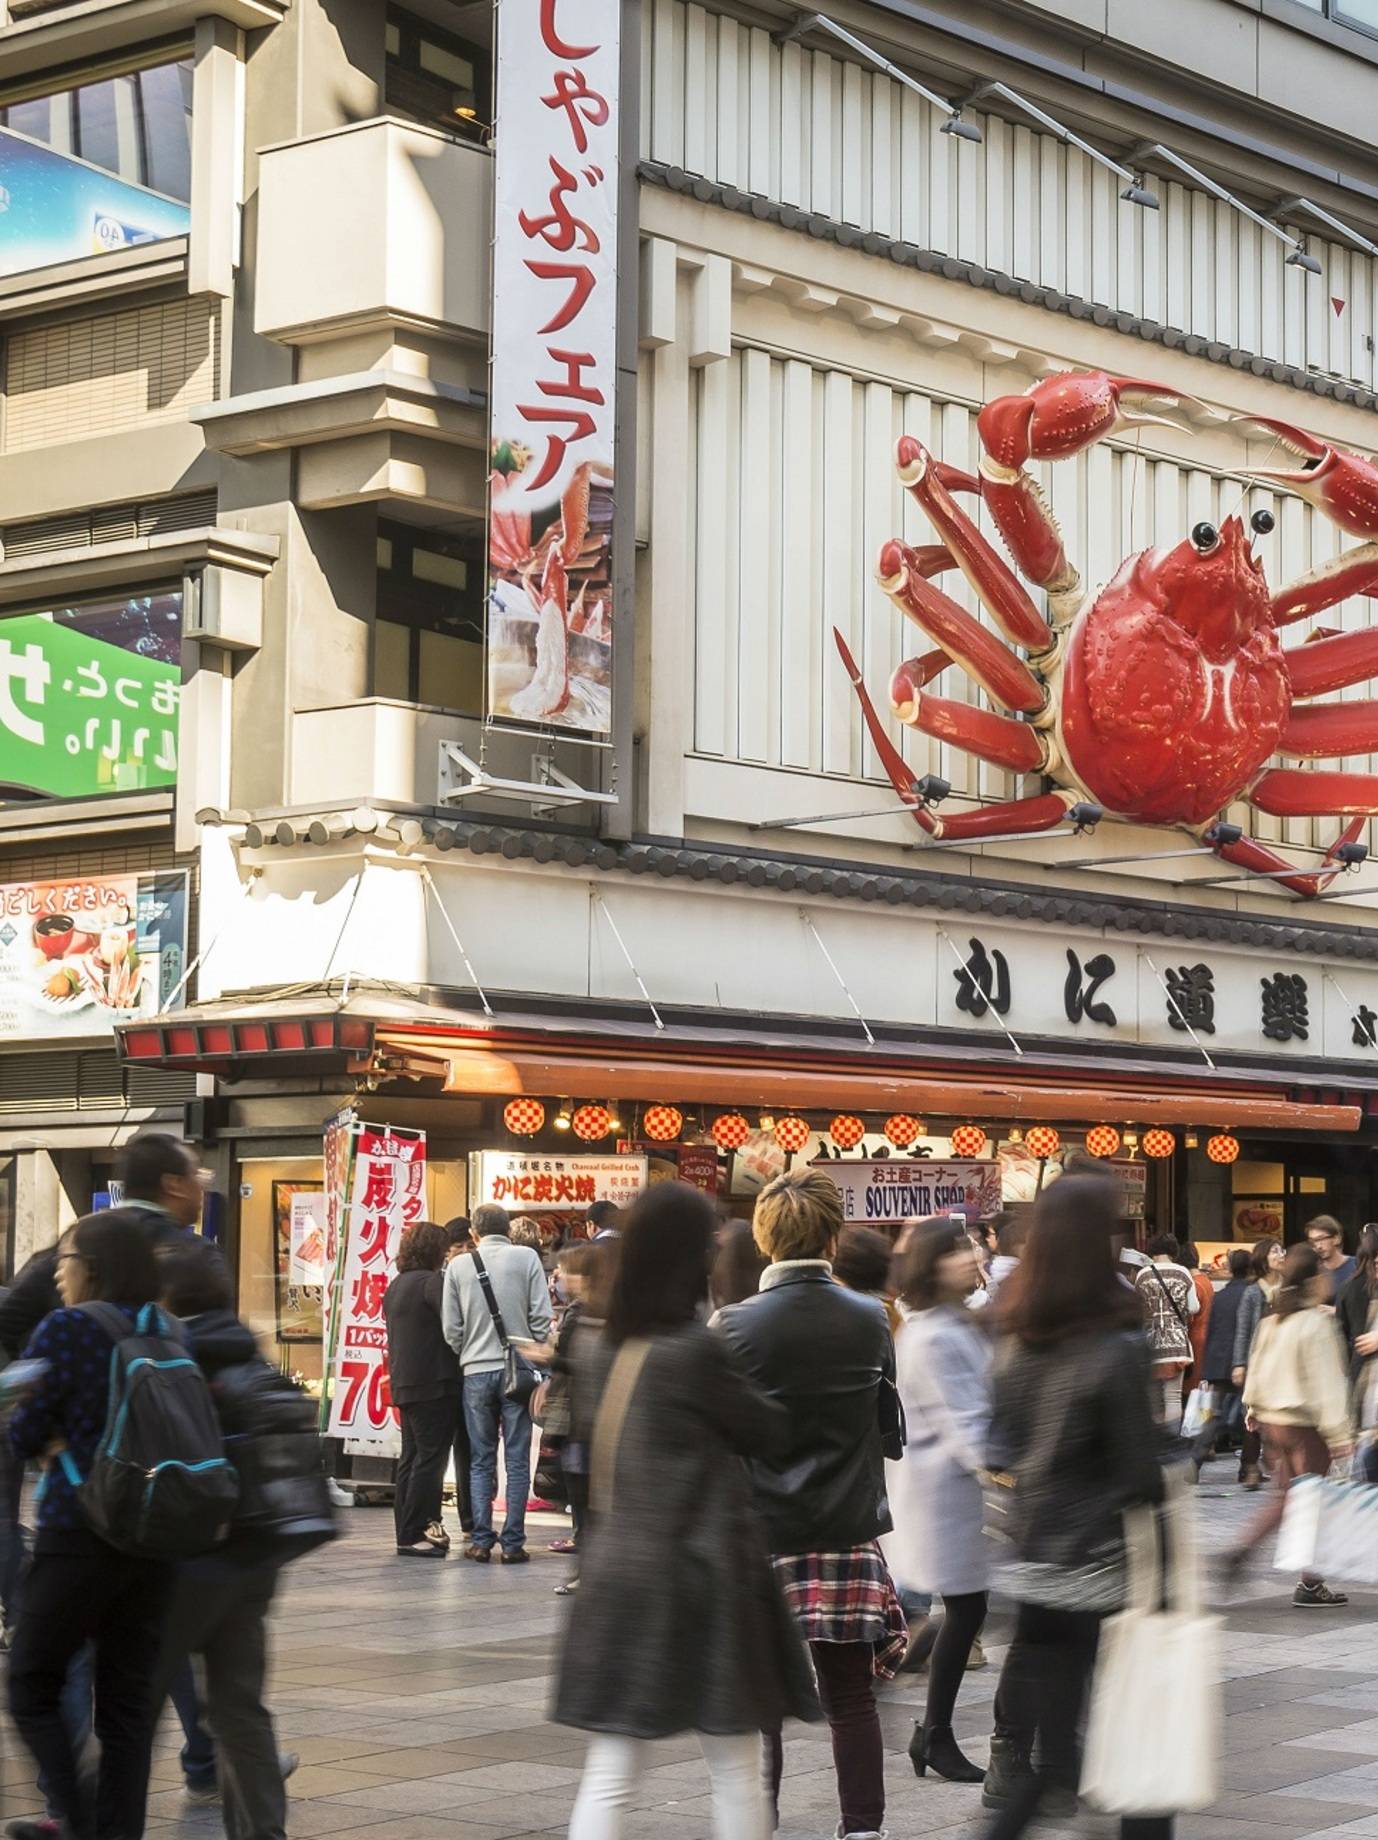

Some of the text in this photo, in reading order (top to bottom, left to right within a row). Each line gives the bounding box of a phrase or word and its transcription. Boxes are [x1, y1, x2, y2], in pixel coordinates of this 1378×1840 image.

[0, 885, 128, 919] ごしください。
[953, 936, 1309, 1042] かに道楽
[492, 1174, 596, 1202] かに炭火焼
[871, 1167, 958, 1184] お土産コーナー
[865, 1186, 932, 1218] SOUVENIR
[339, 1361, 403, 1430] 70
